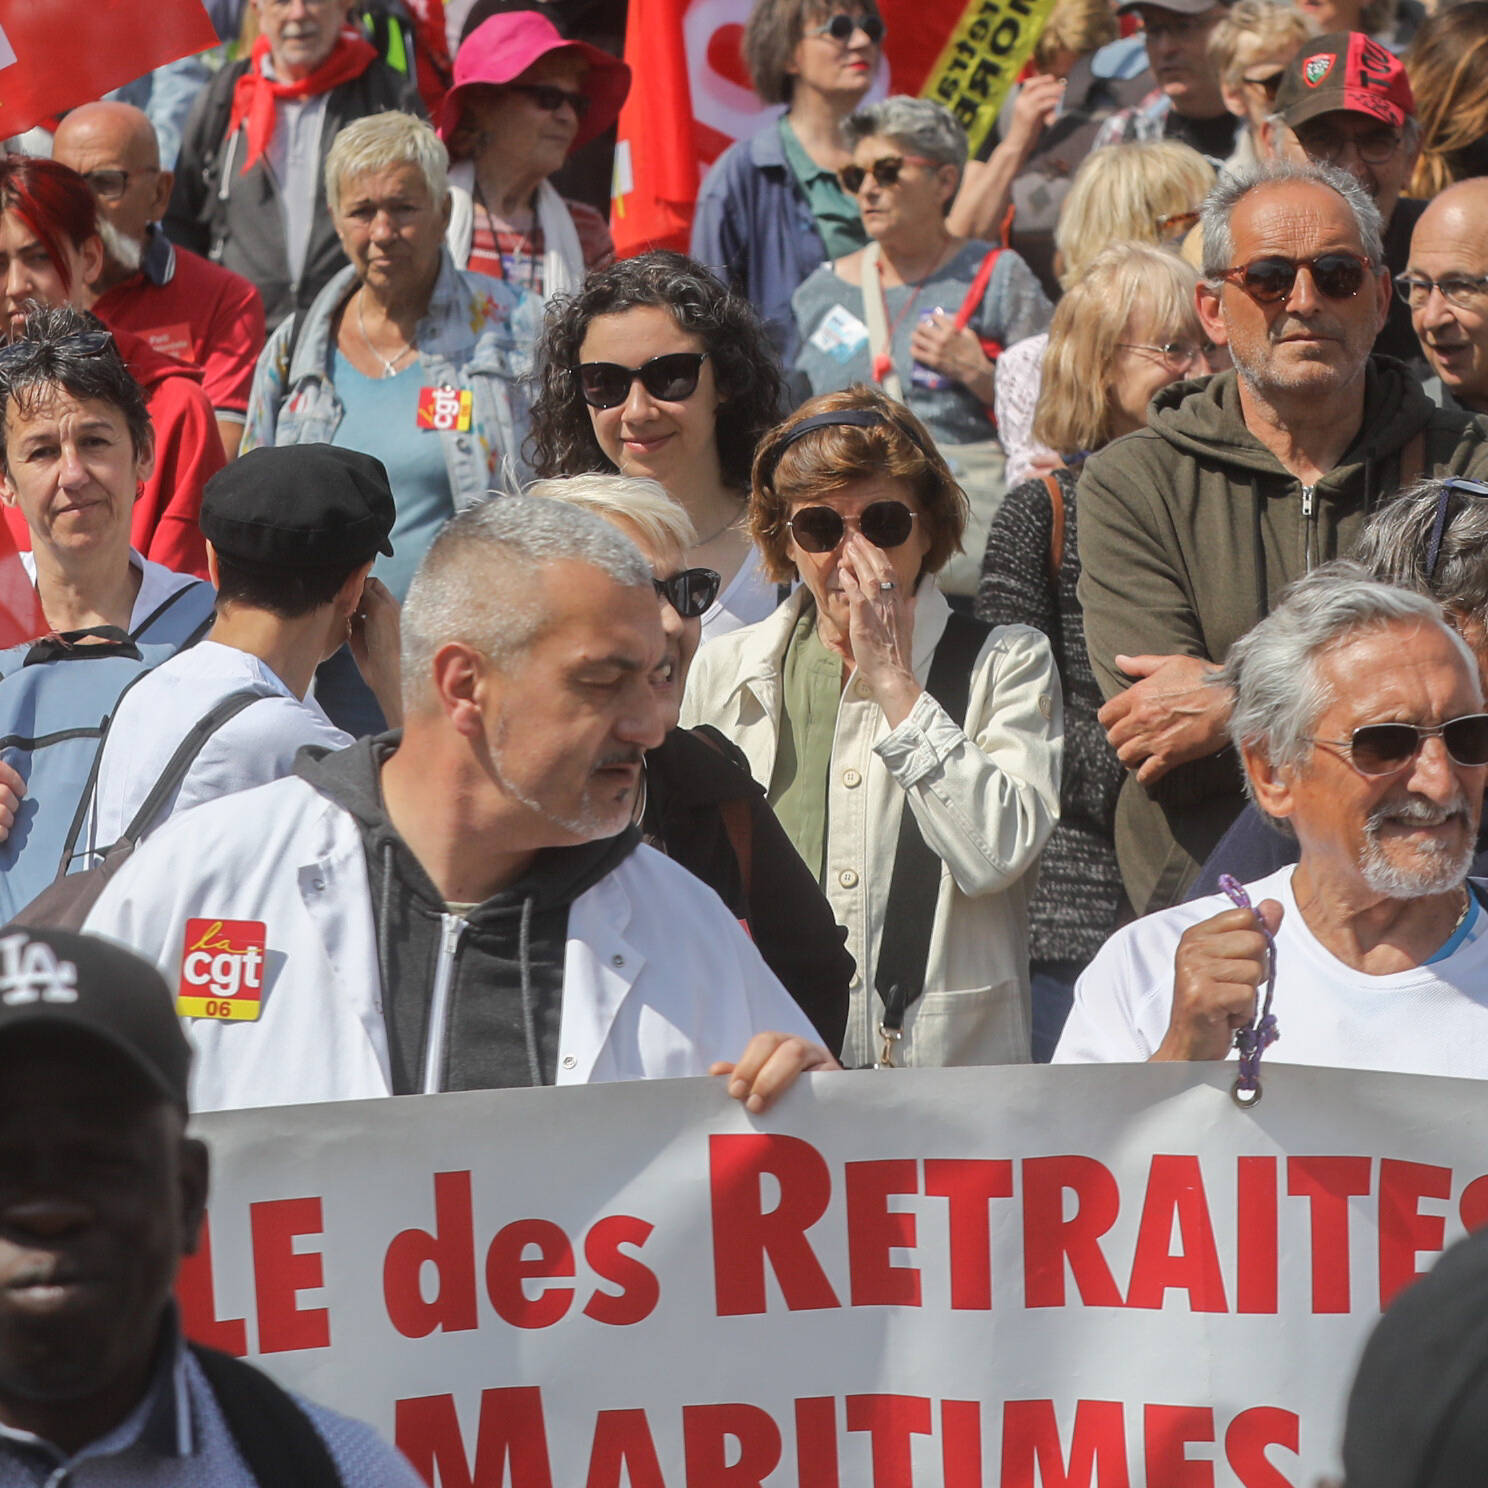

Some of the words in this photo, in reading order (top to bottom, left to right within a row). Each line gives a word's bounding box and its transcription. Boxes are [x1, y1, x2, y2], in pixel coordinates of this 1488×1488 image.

[432, 389, 461, 429] cgt
[189, 921, 263, 955] la
[183, 945, 263, 998] cgt
[205, 1000, 232, 1018] 06
[383, 1169, 662, 1341] des
